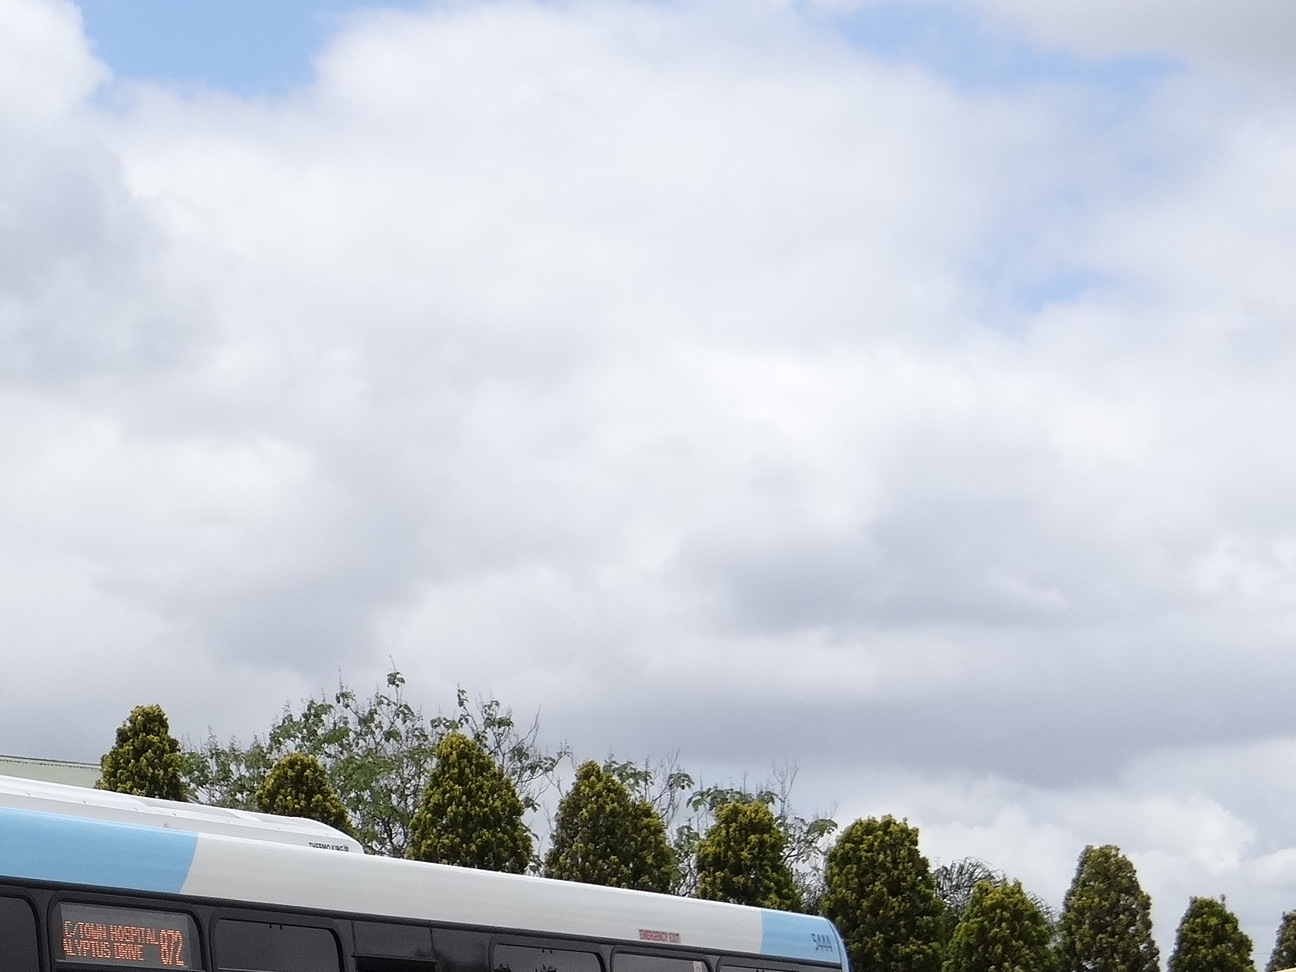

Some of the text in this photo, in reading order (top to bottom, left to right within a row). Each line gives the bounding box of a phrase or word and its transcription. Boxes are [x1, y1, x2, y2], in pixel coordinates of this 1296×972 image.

[64, 920, 184, 966] C/TOWN HOSPITAL 872
[114, 942, 144, 961] DRIVE
